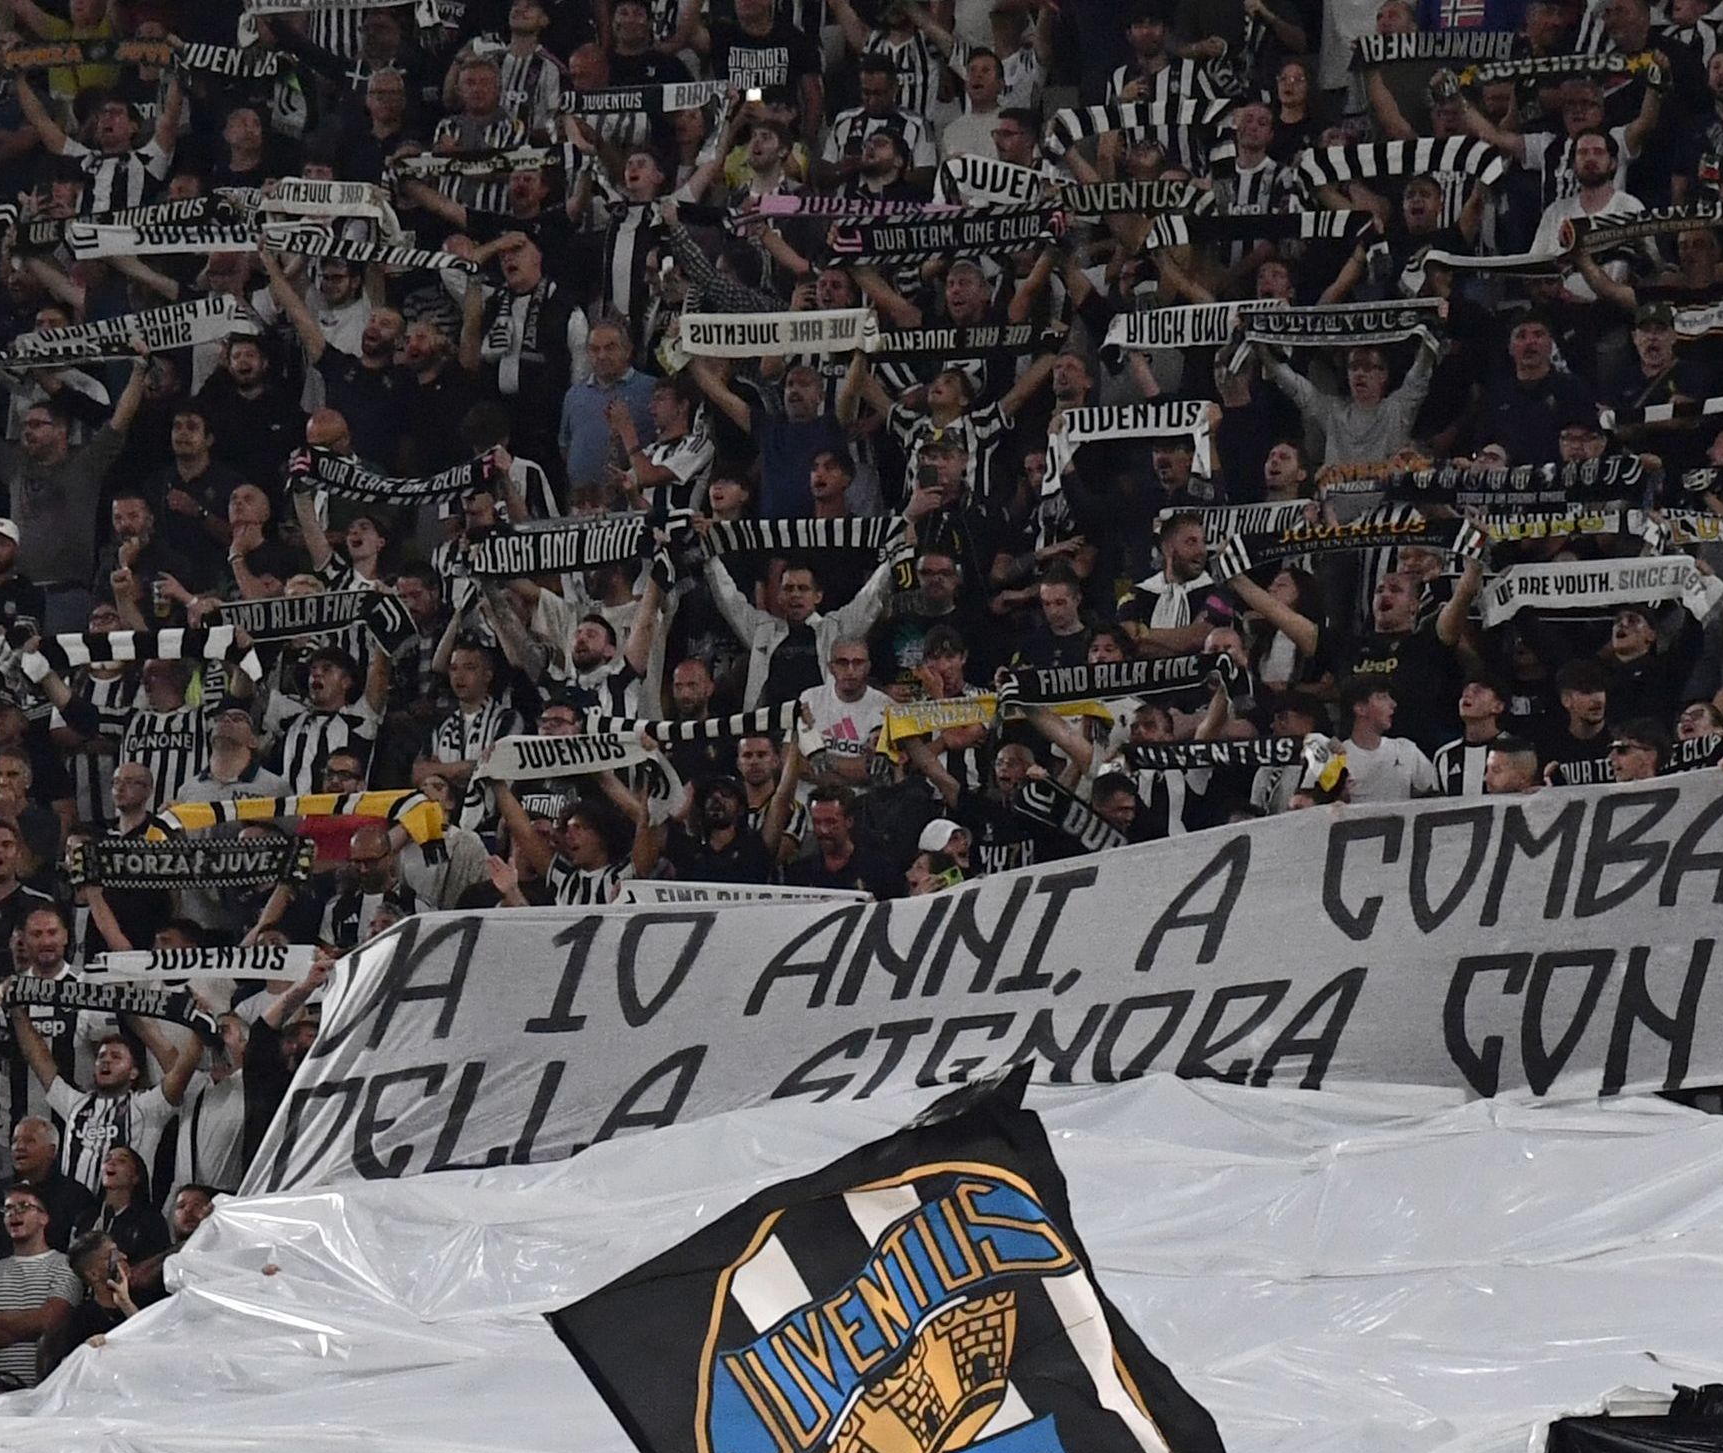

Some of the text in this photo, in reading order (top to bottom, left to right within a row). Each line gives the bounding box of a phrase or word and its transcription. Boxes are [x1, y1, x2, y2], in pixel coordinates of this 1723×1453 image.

[584, 89, 643, 113] JUVENTUS
[112, 198, 207, 226] JUVENTUS
[1064, 181, 1186, 212] JUVENTUS
[872, 227, 907, 251] OUR
[963, 220, 994, 244] ONE
[999, 214, 1040, 240] CLUB
[878, 327, 959, 353] JUVENTU
[1064, 402, 1202, 435] JUVENTUS
[539, 528, 581, 570] AND
[1519, 576, 1553, 599] ARE
[1555, 574, 1616, 597] YOUTH.
[1620, 570, 1672, 592] SINCE
[270, 597, 318, 630] ALLA
[321, 592, 367, 622] FINE
[1093, 660, 1151, 691] ALLA
[126, 728, 194, 751] DANONE
[514, 733, 627, 771] JUVENTUS
[110, 849, 272, 877] FORZA JUVE
[1135, 834, 1253, 972] A
[146, 943, 287, 973] JUVENTUS
[1443, 936, 1718, 1098] CON
[76, 1123, 120, 1143] Jeep
